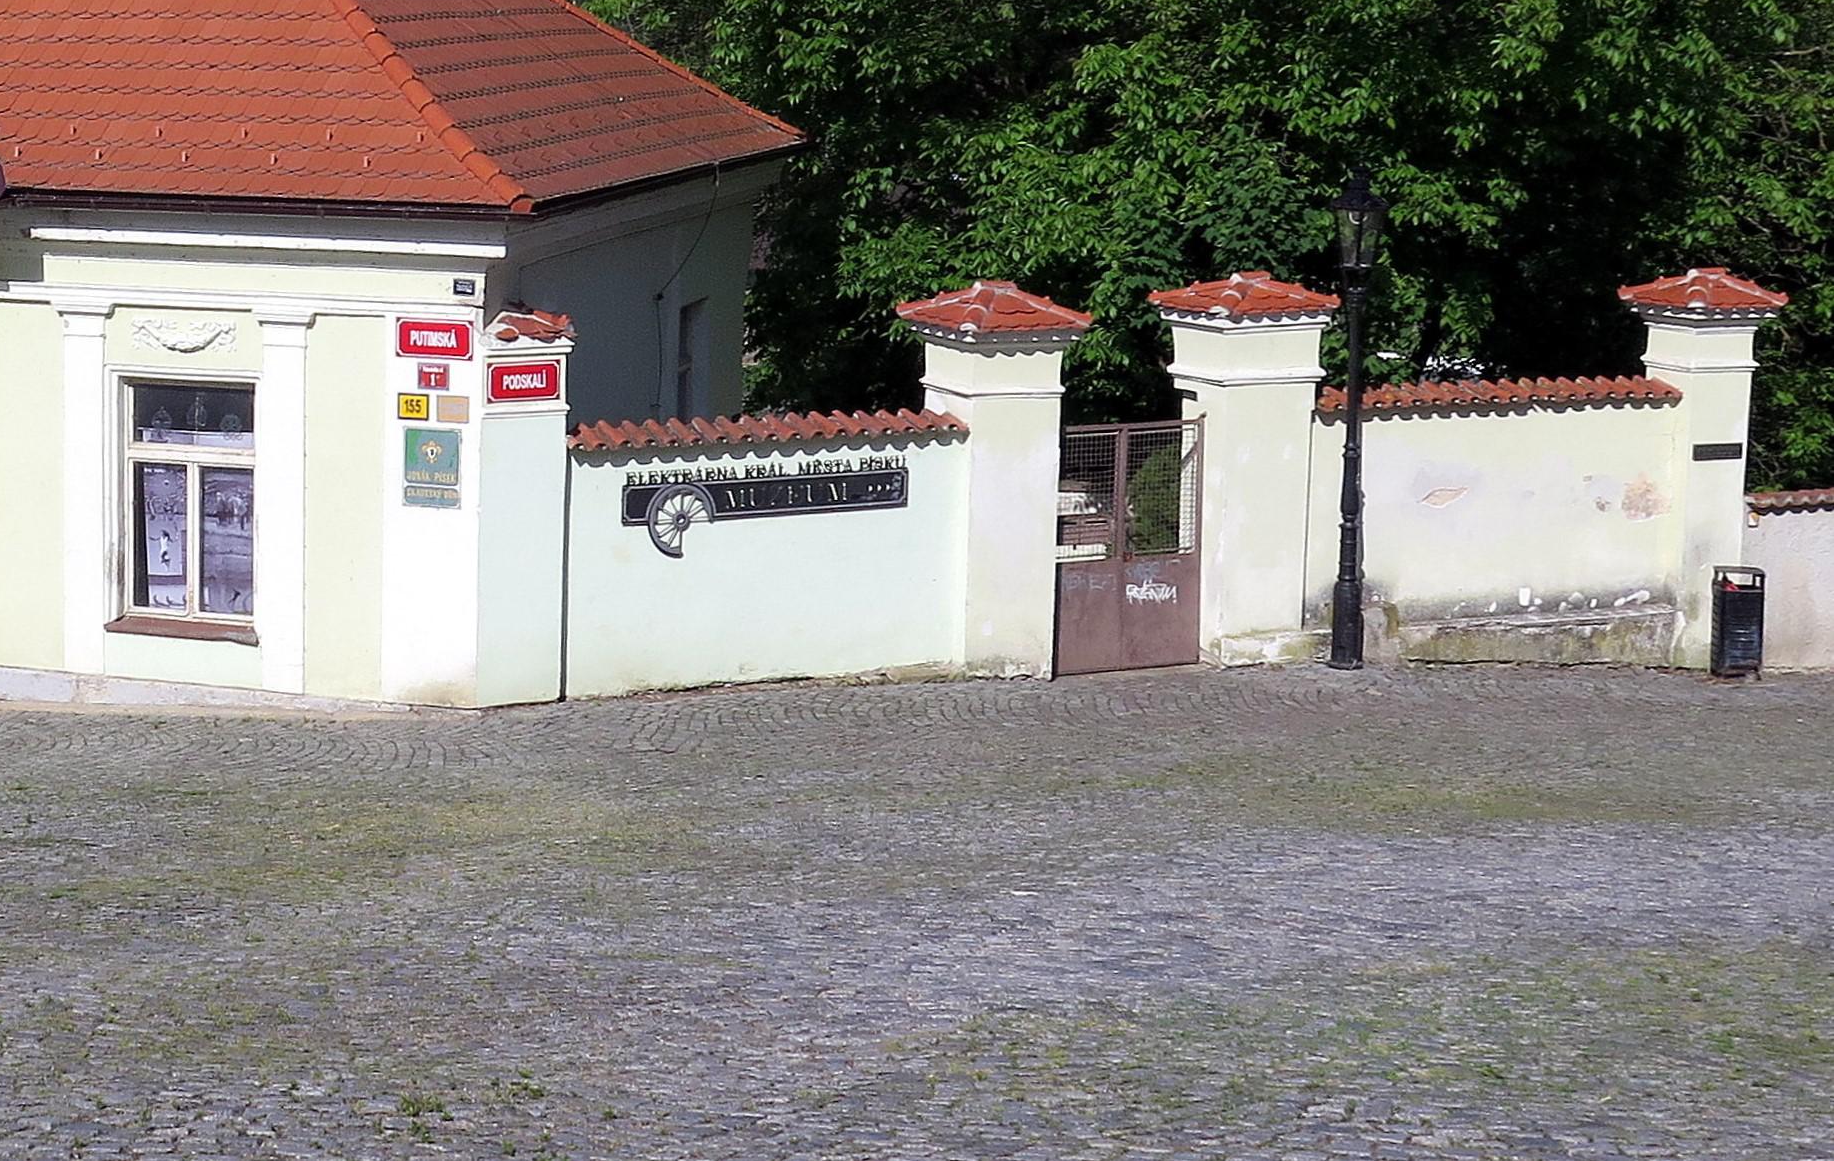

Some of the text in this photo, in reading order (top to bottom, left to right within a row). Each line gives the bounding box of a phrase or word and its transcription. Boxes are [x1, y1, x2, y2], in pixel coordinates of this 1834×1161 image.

[409, 328, 458, 348] PUTIMSKÁ
[502, 369, 547, 390] PODSKALÍ
[404, 399, 422, 413] 155
[625, 465, 738, 486] ELEKTRÁRNA
